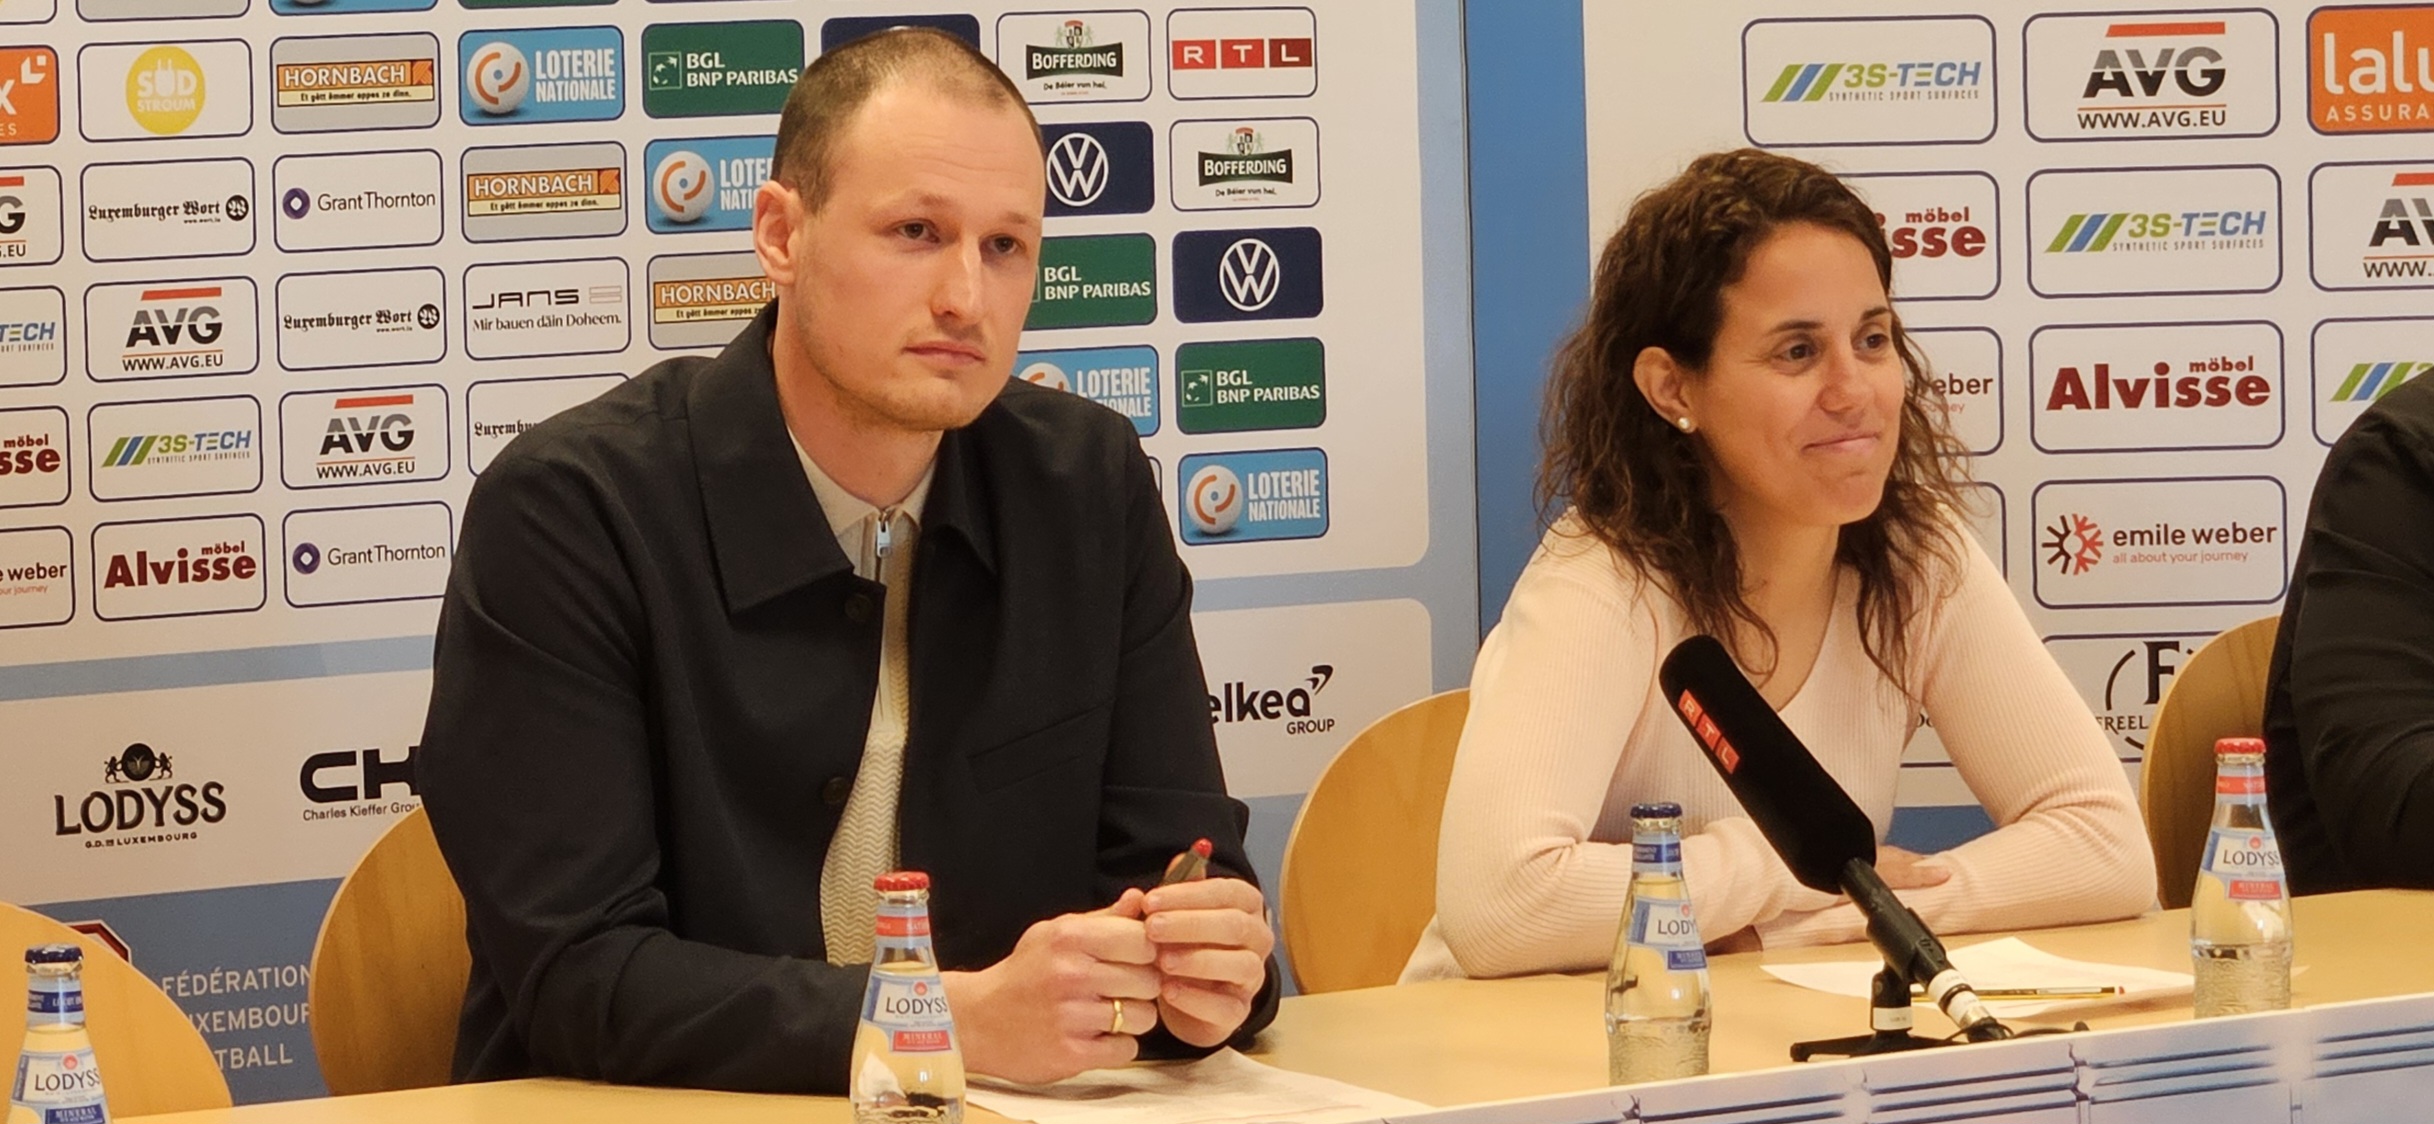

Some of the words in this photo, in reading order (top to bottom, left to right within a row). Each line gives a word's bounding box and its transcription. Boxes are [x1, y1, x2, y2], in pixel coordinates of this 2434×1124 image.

[535, 48, 616, 81] LOTERIE
[686, 52, 725, 70] BGL
[1032, 52, 1117, 70] BOFFERDING
[1183, 44, 1300, 65] RTL
[284, 64, 405, 87] HORNBACH
[686, 71, 722, 87] BNP
[726, 68, 798, 86] PARIBAS
[1843, 61, 1982, 88] 3S-TECH
[2082, 46, 2227, 99] AVG
[535, 78, 616, 103] NATIONALE
[1890, 90, 1921, 101] SPORT
[1927, 89, 1980, 100] SURFACES
[2077, 109, 2227, 130] WWW.AVG.EU
[1203, 158, 1287, 176] BOFFERDING
[474, 173, 592, 197] HORNBACH
[317, 193, 363, 211] Grant
[363, 191, 436, 209] Thornton
[720, 188, 757, 211] NATI
[88, 202, 180, 222] Luxemburger
[183, 200, 220, 215] Wort
[1905, 206, 1970, 223] möbel
[2128, 211, 2267, 238] 3S-TECH
[2174, 239, 2206, 251] SPORT
[2212, 238, 2265, 250] SURFACES
[1044, 266, 1081, 282] BGL
[660, 281, 777, 304] HORNBACH
[1044, 284, 1079, 300] BNP
[1083, 281, 1151, 298] PARIBAS
[126, 306, 223, 348] AVG
[283, 312, 372, 332] Luxemburger
[375, 309, 412, 324] Wort
[473, 319, 494, 332] Mir
[496, 316, 534, 331] bauen
[122, 354, 224, 372] WWW.AVG.EU
[2189, 356, 2254, 373] möbel
[1077, 367, 1151, 398] LOTERIE
[1216, 370, 1252, 387] BGL
[2046, 362, 2271, 411] Alvisse
[1217, 388, 1250, 404] BNP
[1254, 384, 1320, 402] PARIBAS
[3, 434, 49, 448] möbel
[158, 430, 251, 454] 3S-TECH
[320, 414, 415, 455] AVG
[316, 461, 416, 479] WWW.AVG.EU
[1248, 469, 1320, 501] LOTERIE
[1248, 498, 1321, 523] NATIONALE
[2113, 523, 2186, 546] emile
[2191, 521, 2278, 544] weber
[201, 540, 245, 555] möbel
[327, 547, 373, 566] Grant
[373, 545, 446, 562] Thornton
[2130, 551, 2167, 563] about
[2170, 551, 2198, 564] your
[2201, 550, 2249, 563] journey
[7, 562, 67, 581] weber
[104, 547, 257, 589] Alvisse
[1286, 718, 1336, 735] GROUP
[54, 781, 227, 836] LODYSS
[303, 807, 347, 821] Charles
[350, 804, 387, 817] Kieffer
[117, 832, 198, 846] LUXEMBOURG
